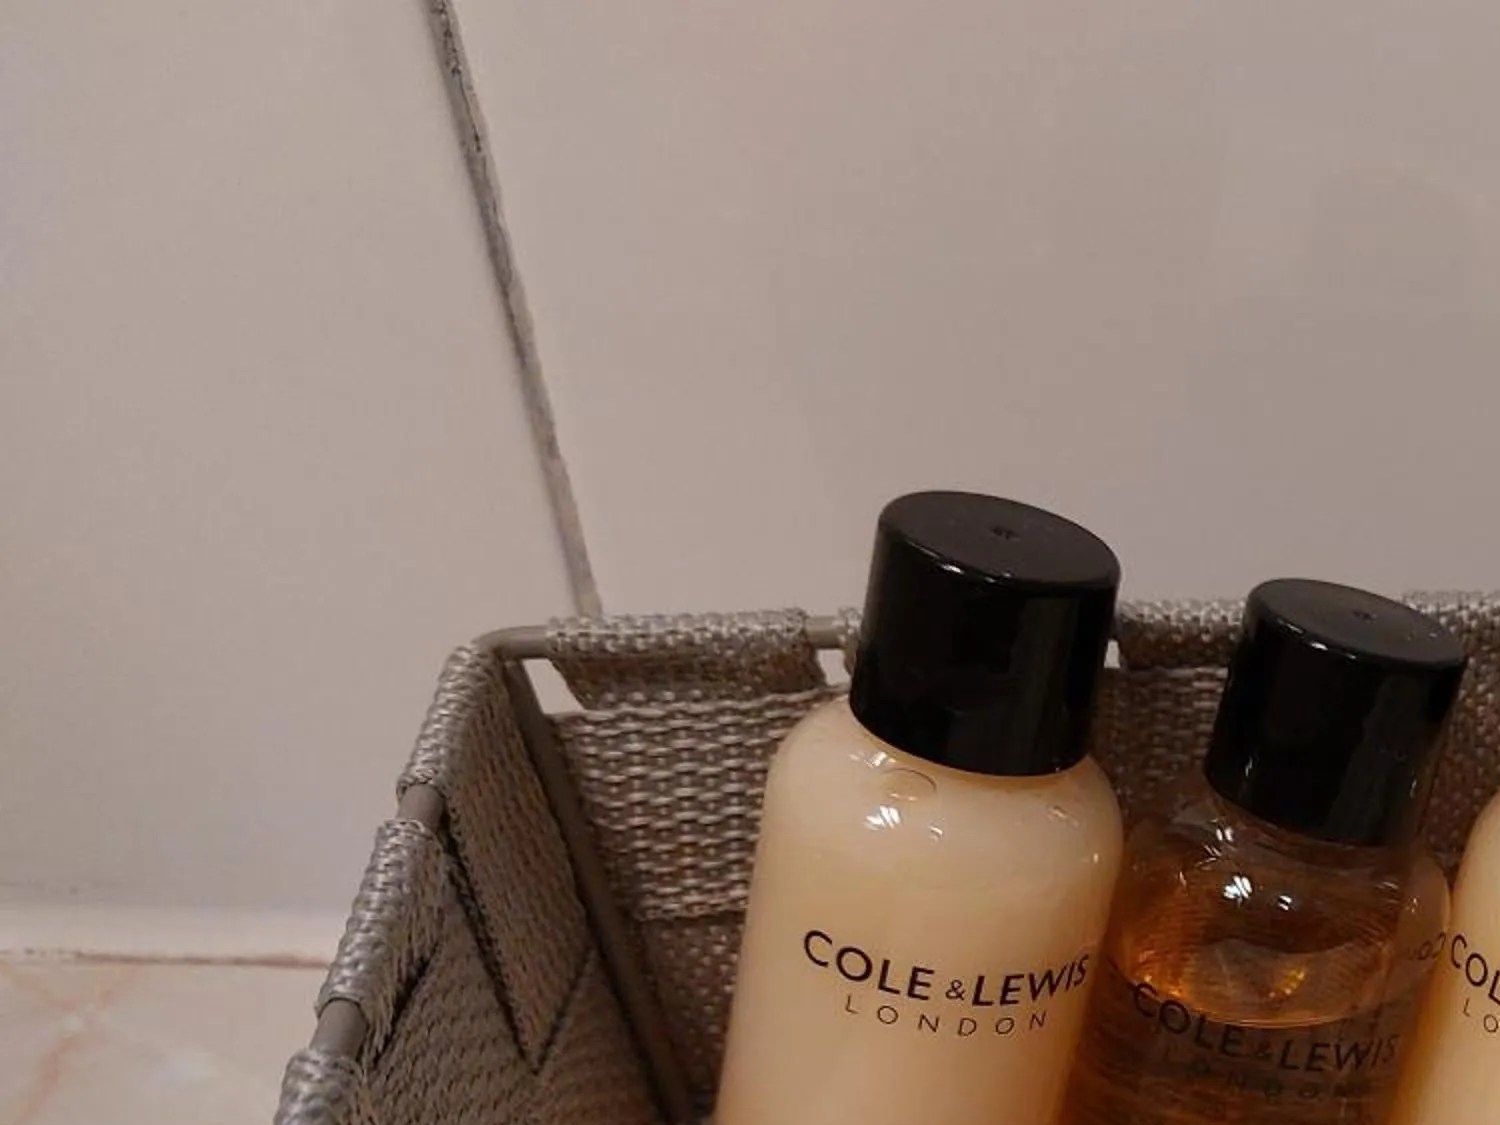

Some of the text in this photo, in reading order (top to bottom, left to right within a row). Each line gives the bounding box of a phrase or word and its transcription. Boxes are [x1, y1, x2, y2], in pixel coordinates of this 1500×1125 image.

[804, 930, 935, 1000] COLE
[971, 953, 1090, 1007] LEWIS
[845, 994, 1047, 1037] LONDON
[1133, 983, 1244, 1058] COLE
[1278, 1034, 1399, 1072] LEWIS
